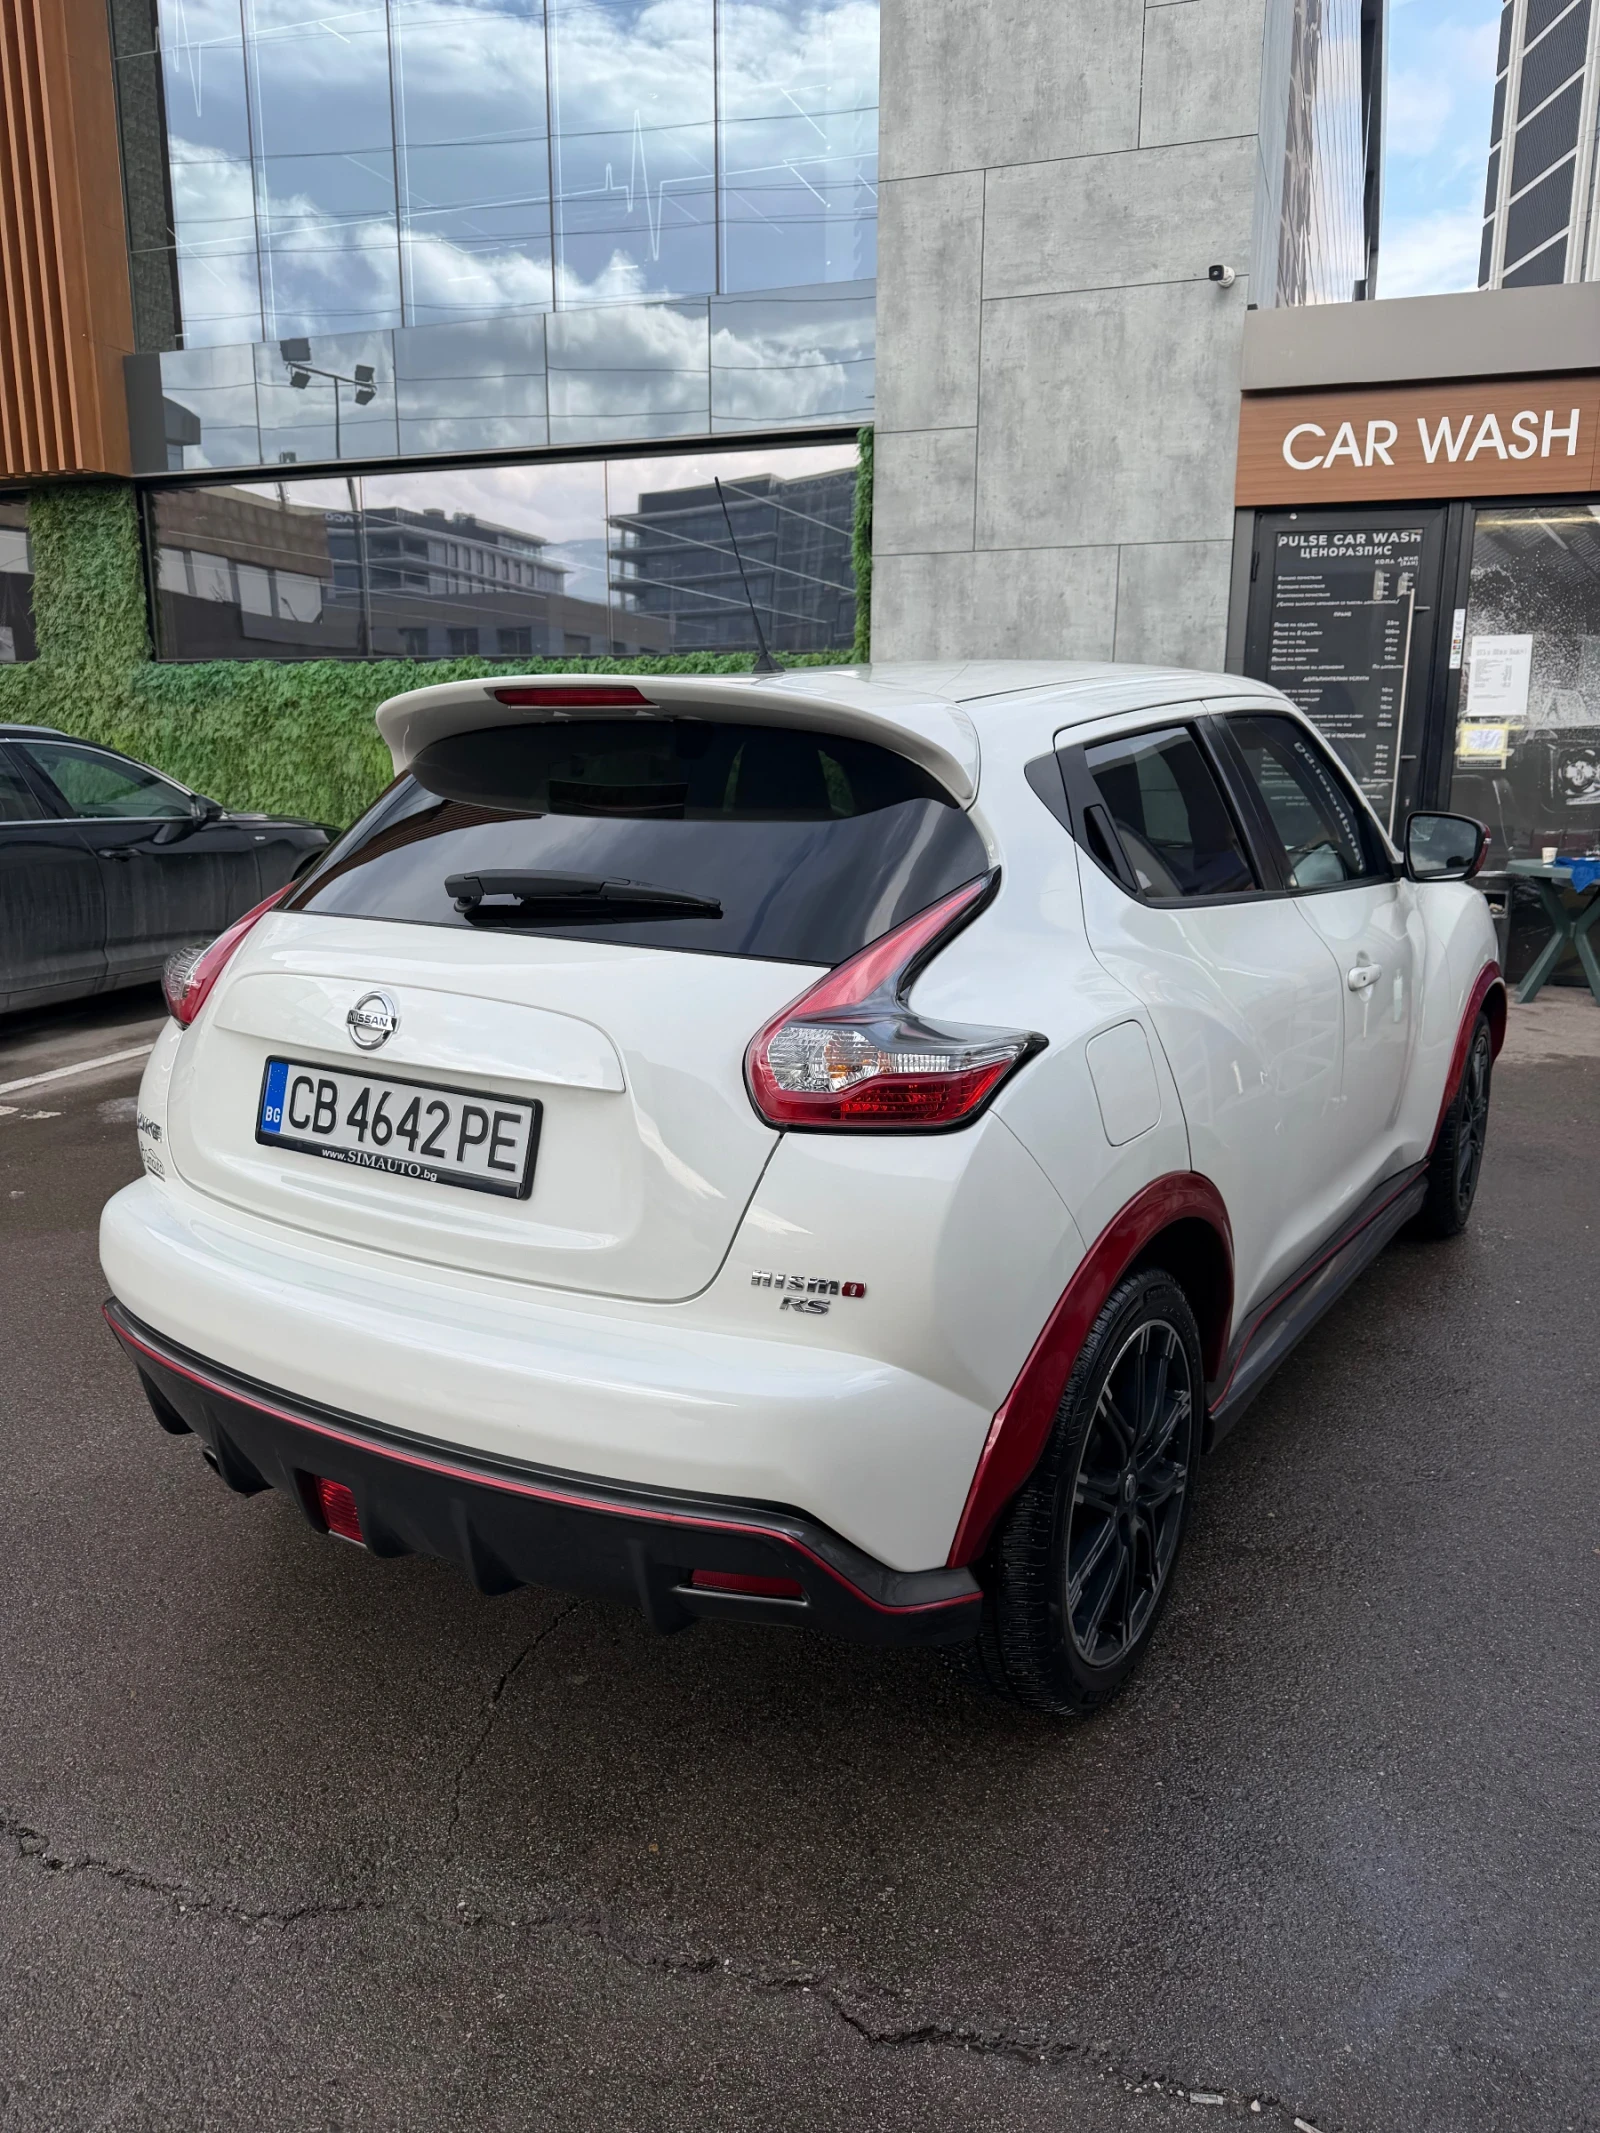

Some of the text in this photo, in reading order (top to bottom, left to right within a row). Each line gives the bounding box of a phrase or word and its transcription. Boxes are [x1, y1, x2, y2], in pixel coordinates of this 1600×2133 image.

[1282, 408, 1580, 471] CAR WASH
[1278, 531, 1421, 547] PULSE CAR WASH
[1300, 546, 1392, 559] ЦЕНОРАЗПИС
[348, 1010, 389, 1028] NISSAN
[265, 1106, 281, 1123] BG
[288, 1075, 522, 1172] CB 4642 PE
[321, 1148, 438, 1182] www.SIMAUTO.bg
[779, 1294, 831, 1316] RS
